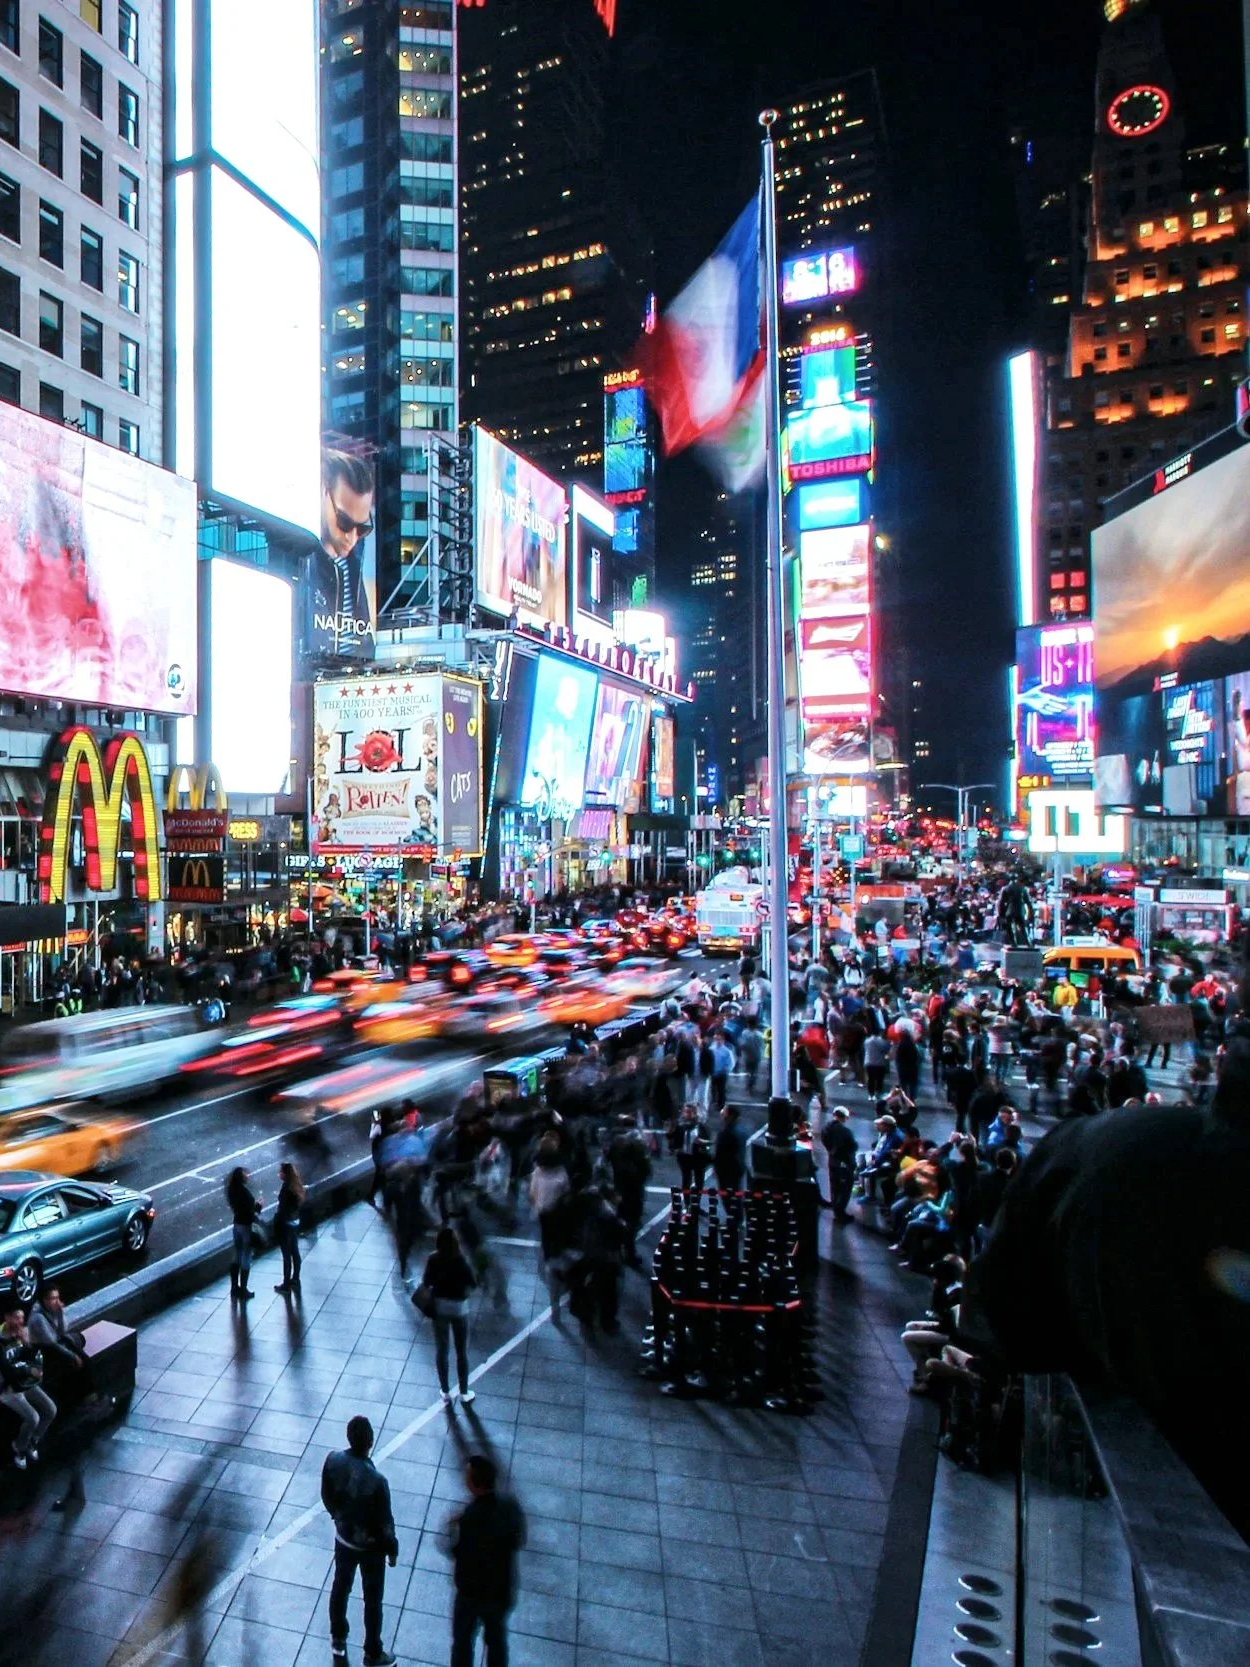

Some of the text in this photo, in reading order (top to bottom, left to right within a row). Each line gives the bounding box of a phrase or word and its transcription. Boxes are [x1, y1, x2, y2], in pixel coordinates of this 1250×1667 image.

[790, 458, 869, 478] TOSHIBA
[314, 613, 373, 636] NAUTICA
[323, 694, 432, 709] THE FUNNIEST MUSICAL
[339, 709, 350, 720] IN
[354, 708, 374, 719] 400
[450, 771, 471, 803] CATS
[167, 818, 224, 828] McDonald's
[334, 855, 404, 869] LUGAGE
